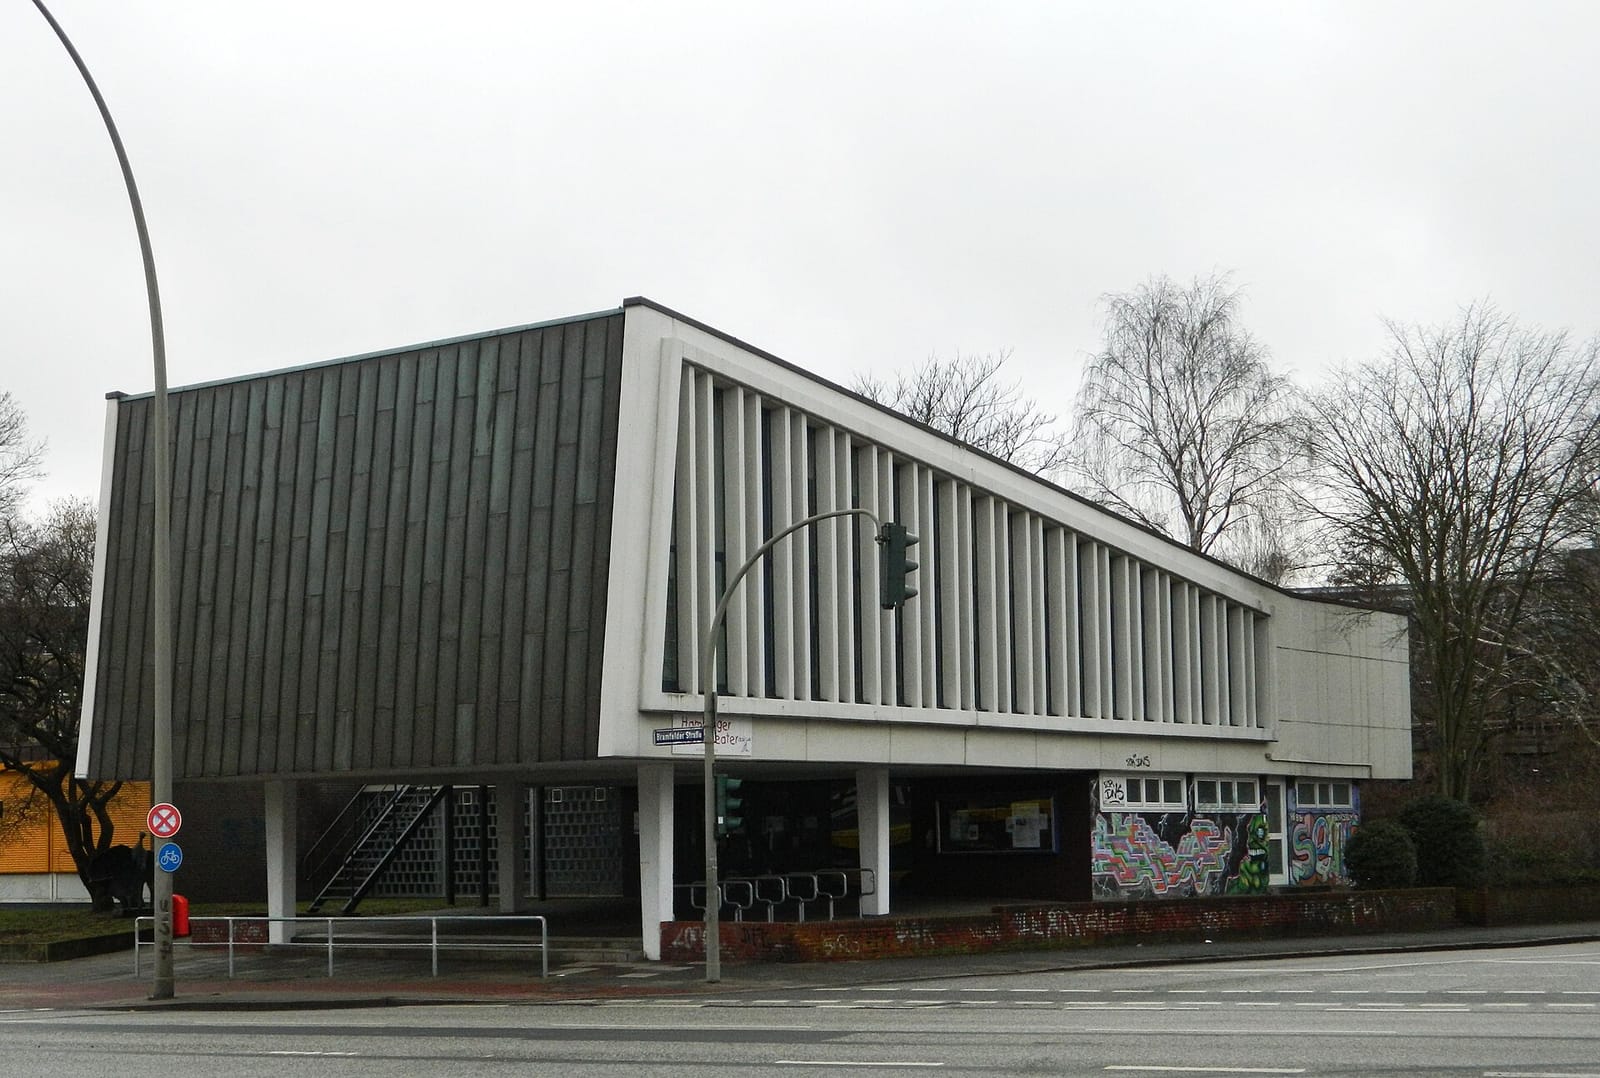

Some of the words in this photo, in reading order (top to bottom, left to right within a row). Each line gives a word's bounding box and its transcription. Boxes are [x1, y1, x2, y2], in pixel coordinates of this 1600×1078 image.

[682, 715, 731, 732] Hamger
[656, 731, 684, 741] Bramfelder
[716, 732, 739, 745] eater
